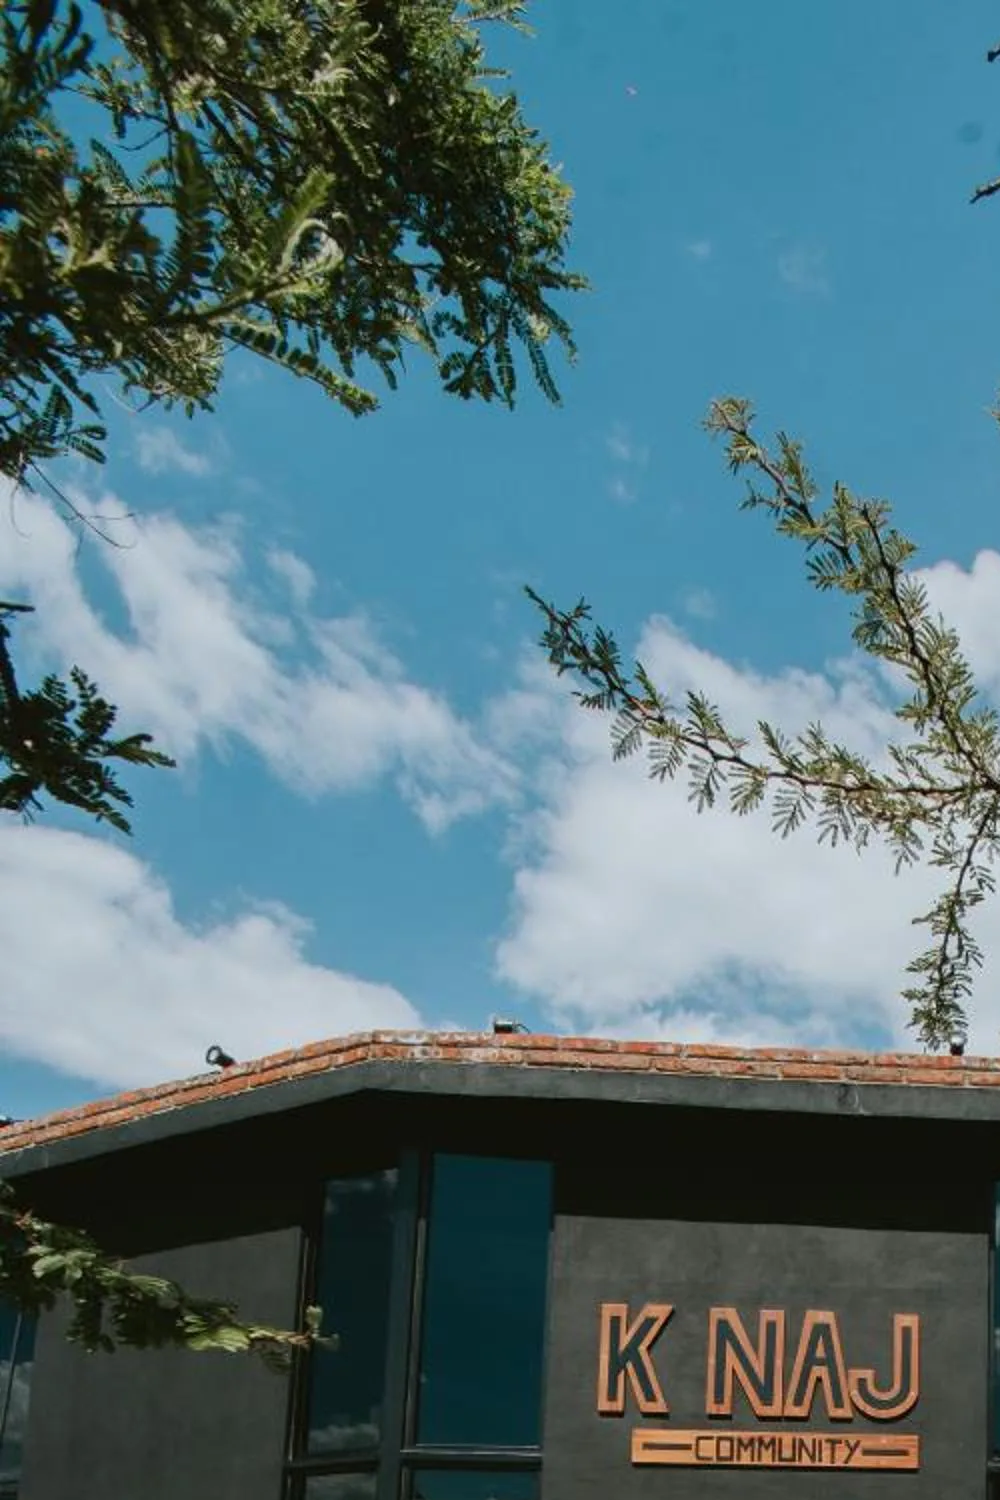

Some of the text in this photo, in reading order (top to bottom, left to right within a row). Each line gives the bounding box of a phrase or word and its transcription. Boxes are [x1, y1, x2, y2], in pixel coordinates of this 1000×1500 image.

[597, 1303, 919, 1419] K NAJ
[694, 1436, 861, 1464] COMMUNITY
